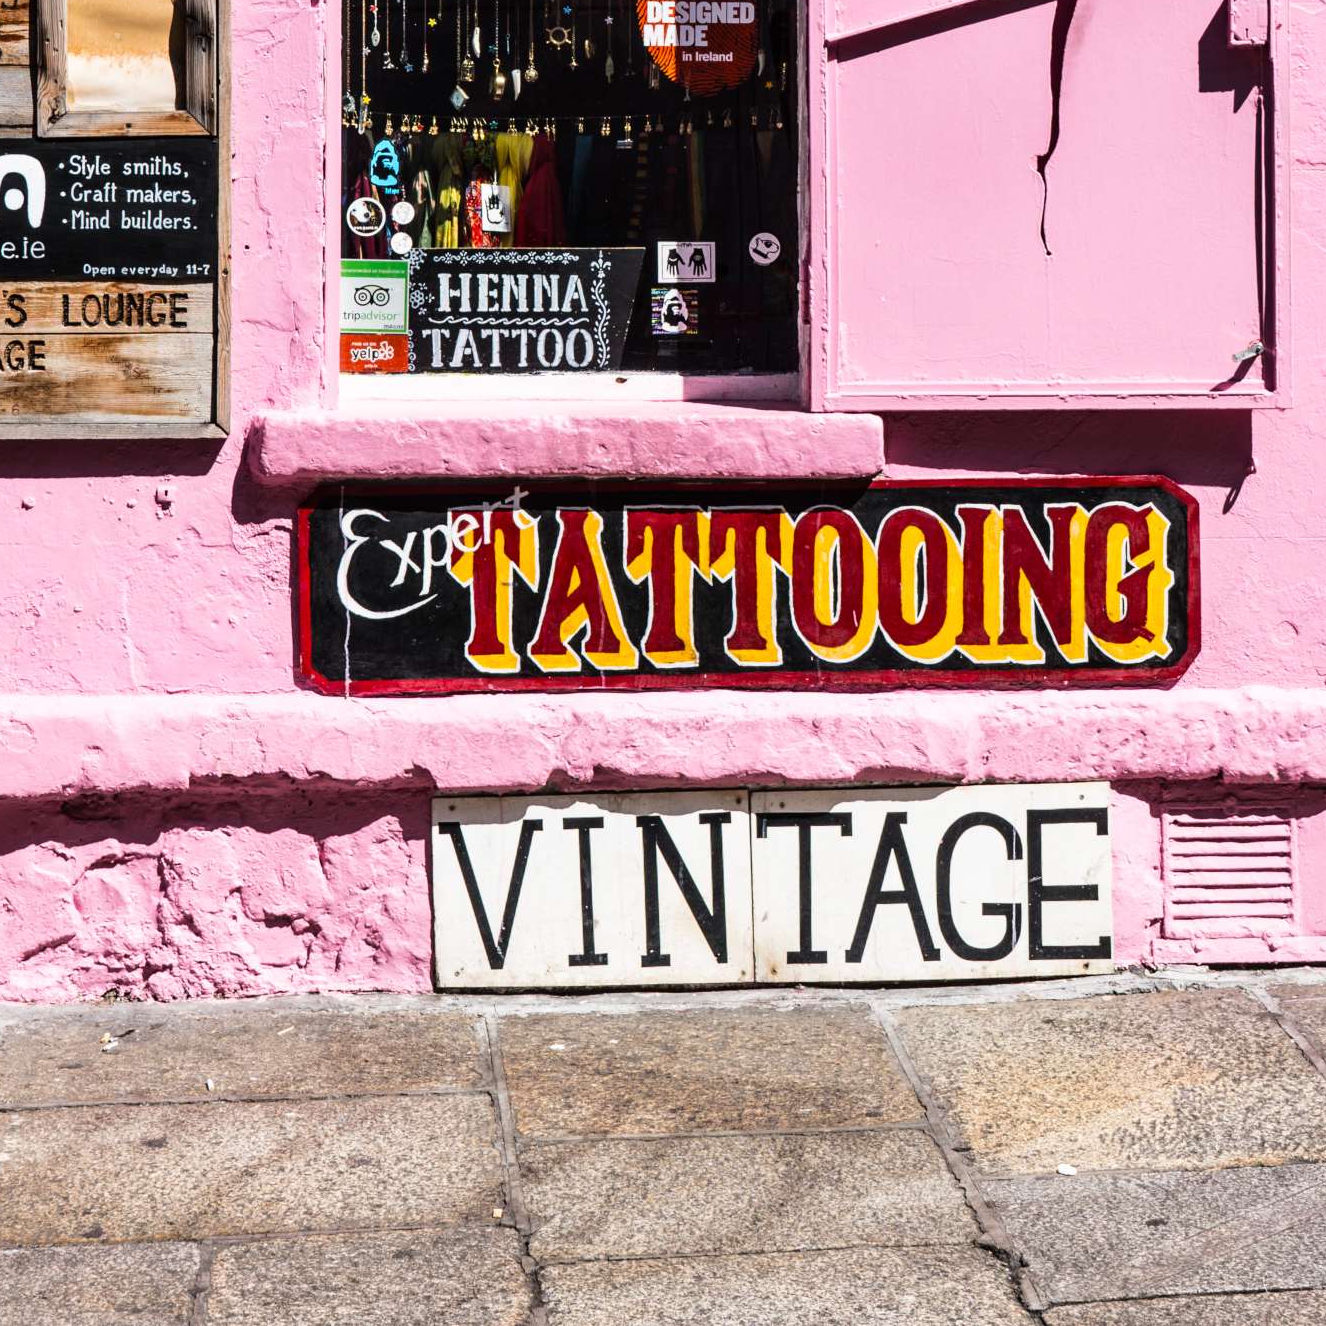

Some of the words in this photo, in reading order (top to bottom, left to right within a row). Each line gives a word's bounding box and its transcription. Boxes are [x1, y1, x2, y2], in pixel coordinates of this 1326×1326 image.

[647, 1, 755, 23] DESIGNED
[643, 24, 708, 46] MADE
[682, 52, 692, 62] in
[695, 52, 733, 62] Ireland
[69, 155, 111, 179] Style
[122, 155, 189, 178] smiths,
[126, 182, 197, 205] makers,
[71, 210, 110, 229] Mind
[121, 210, 197, 229] builders.
[83, 264, 115, 276] Open
[121, 264, 178, 277] everyday
[186, 264, 210, 275] 11-7
[438, 273, 589, 312] HENNA
[62, 293, 189, 329] LOUNGE
[343, 311, 397, 321] tripadvisor
[351, 347, 380, 362] yelp
[422, 329, 594, 367] TATTOO
[337, 486, 541, 619] Expert
[447, 503, 1173, 672] TATTOOING
[438, 807, 1112, 970] VINTAGE
